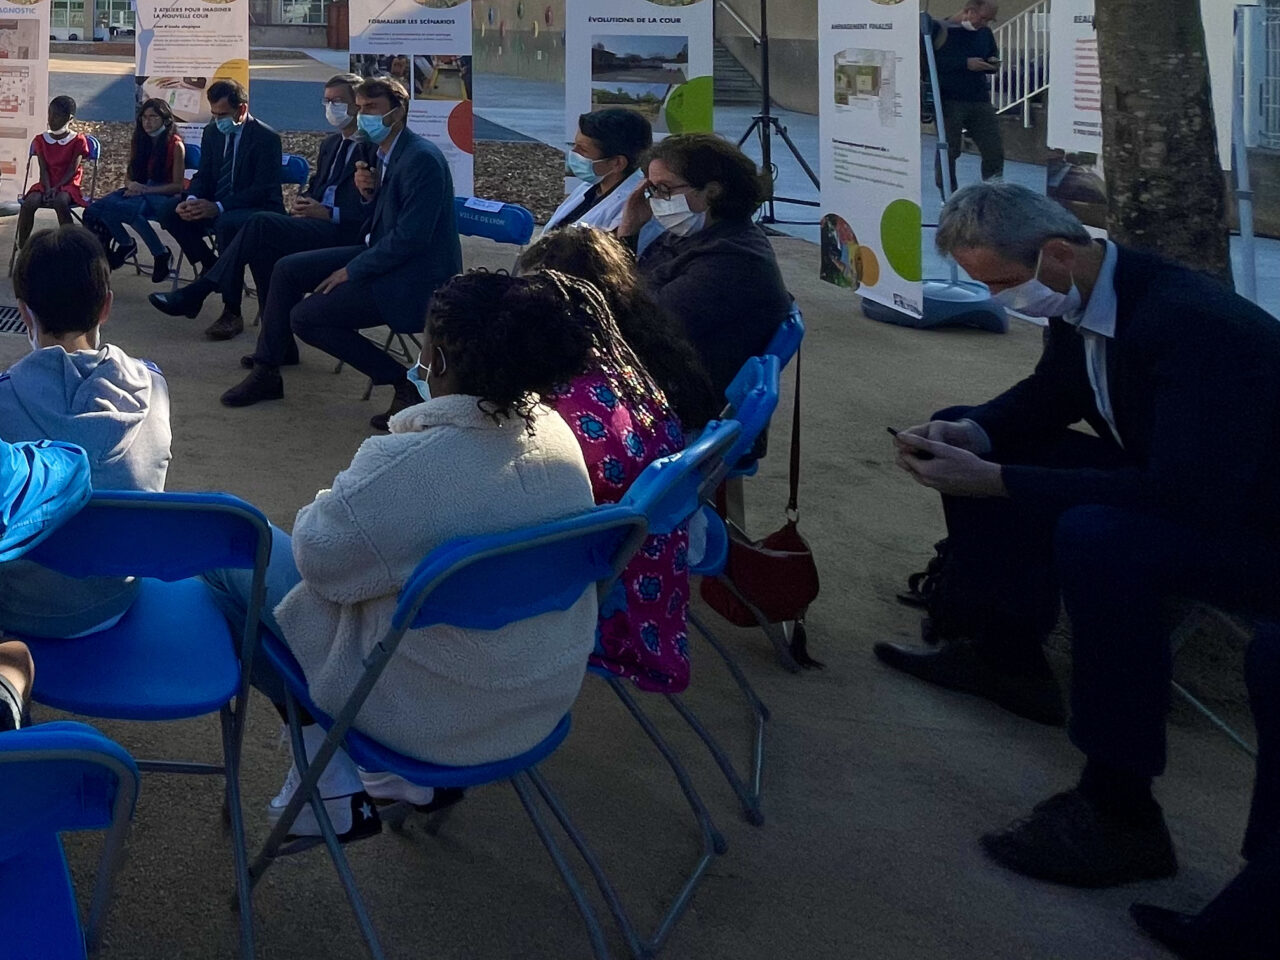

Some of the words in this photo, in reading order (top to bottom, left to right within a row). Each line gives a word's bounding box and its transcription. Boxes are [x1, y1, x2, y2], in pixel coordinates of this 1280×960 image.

[460, 212, 478, 221] VILLE
[480, 216, 488, 224] DE
[490, 218, 505, 226] LYON
